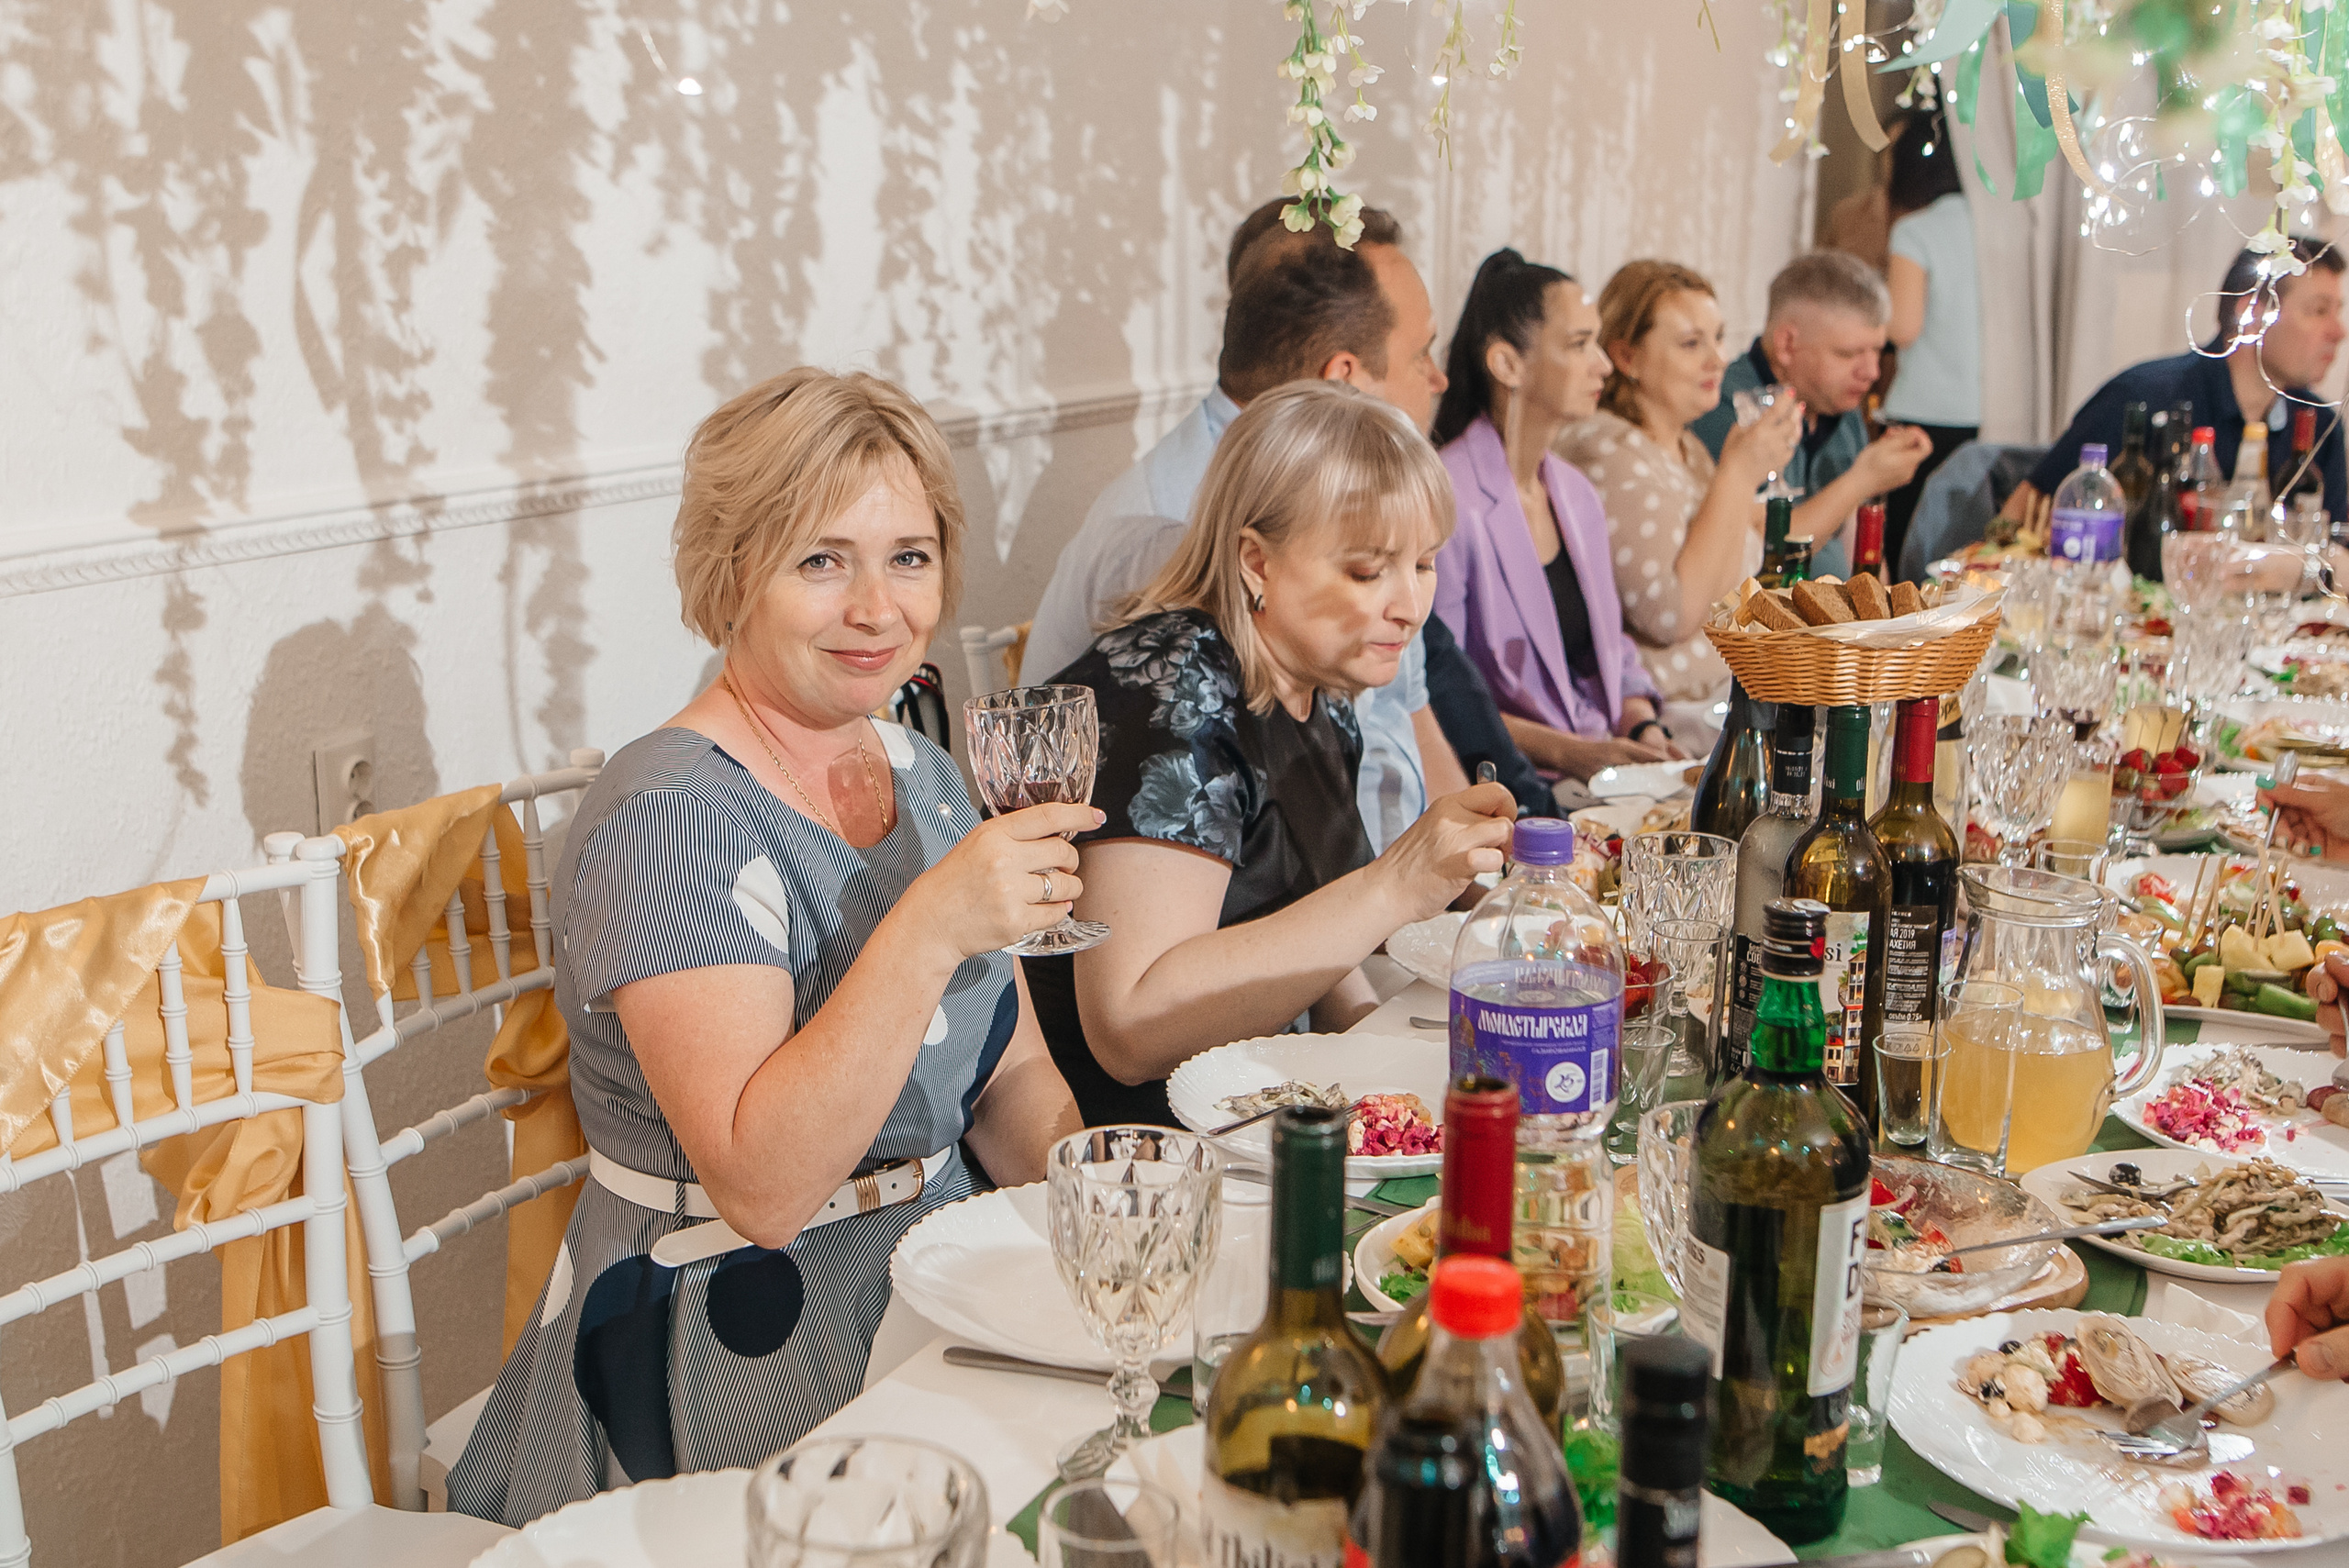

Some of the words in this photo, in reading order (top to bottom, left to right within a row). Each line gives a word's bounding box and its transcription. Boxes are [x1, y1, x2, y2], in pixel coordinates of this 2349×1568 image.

[1899, 929, 1916, 940] 2019
[1824, 942, 1842, 962] si
[1477, 1008, 1588, 1040] МОНАСТЫРСКАЯ
